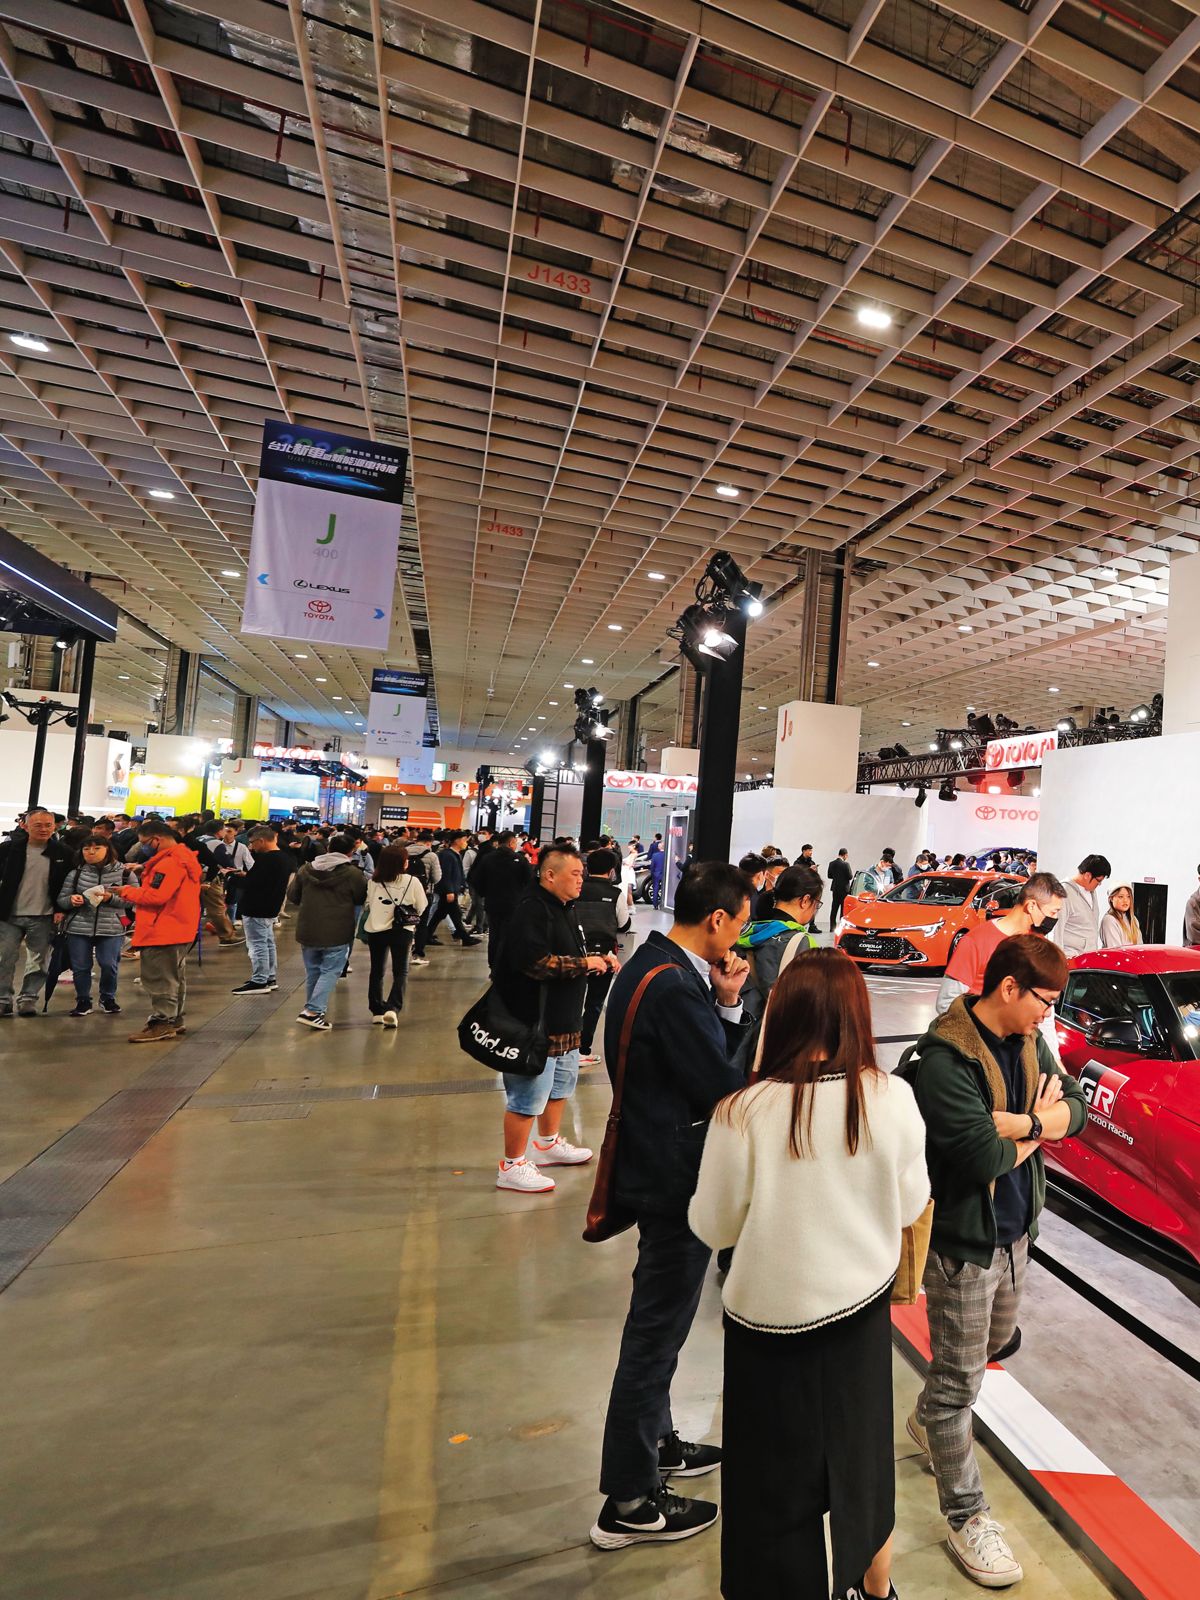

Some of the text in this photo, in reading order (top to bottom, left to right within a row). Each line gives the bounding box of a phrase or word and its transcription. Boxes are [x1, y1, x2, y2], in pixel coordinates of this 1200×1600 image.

[528, 265, 591, 295] J1433
[316, 513, 337, 545] J
[487, 523, 524, 537] J1433
[313, 547, 339, 560] 400
[309, 583, 350, 594] LEXUS
[303, 611, 335, 622] TOYOTA
[392, 703, 401, 717] J
[780, 709, 788, 742] J
[636, 776, 697, 791] TOYOTA
[999, 809, 1040, 821] TOYO
[1079, 1077, 1115, 1115] GR
[1087, 1112, 1134, 1146] AZOO Racing
